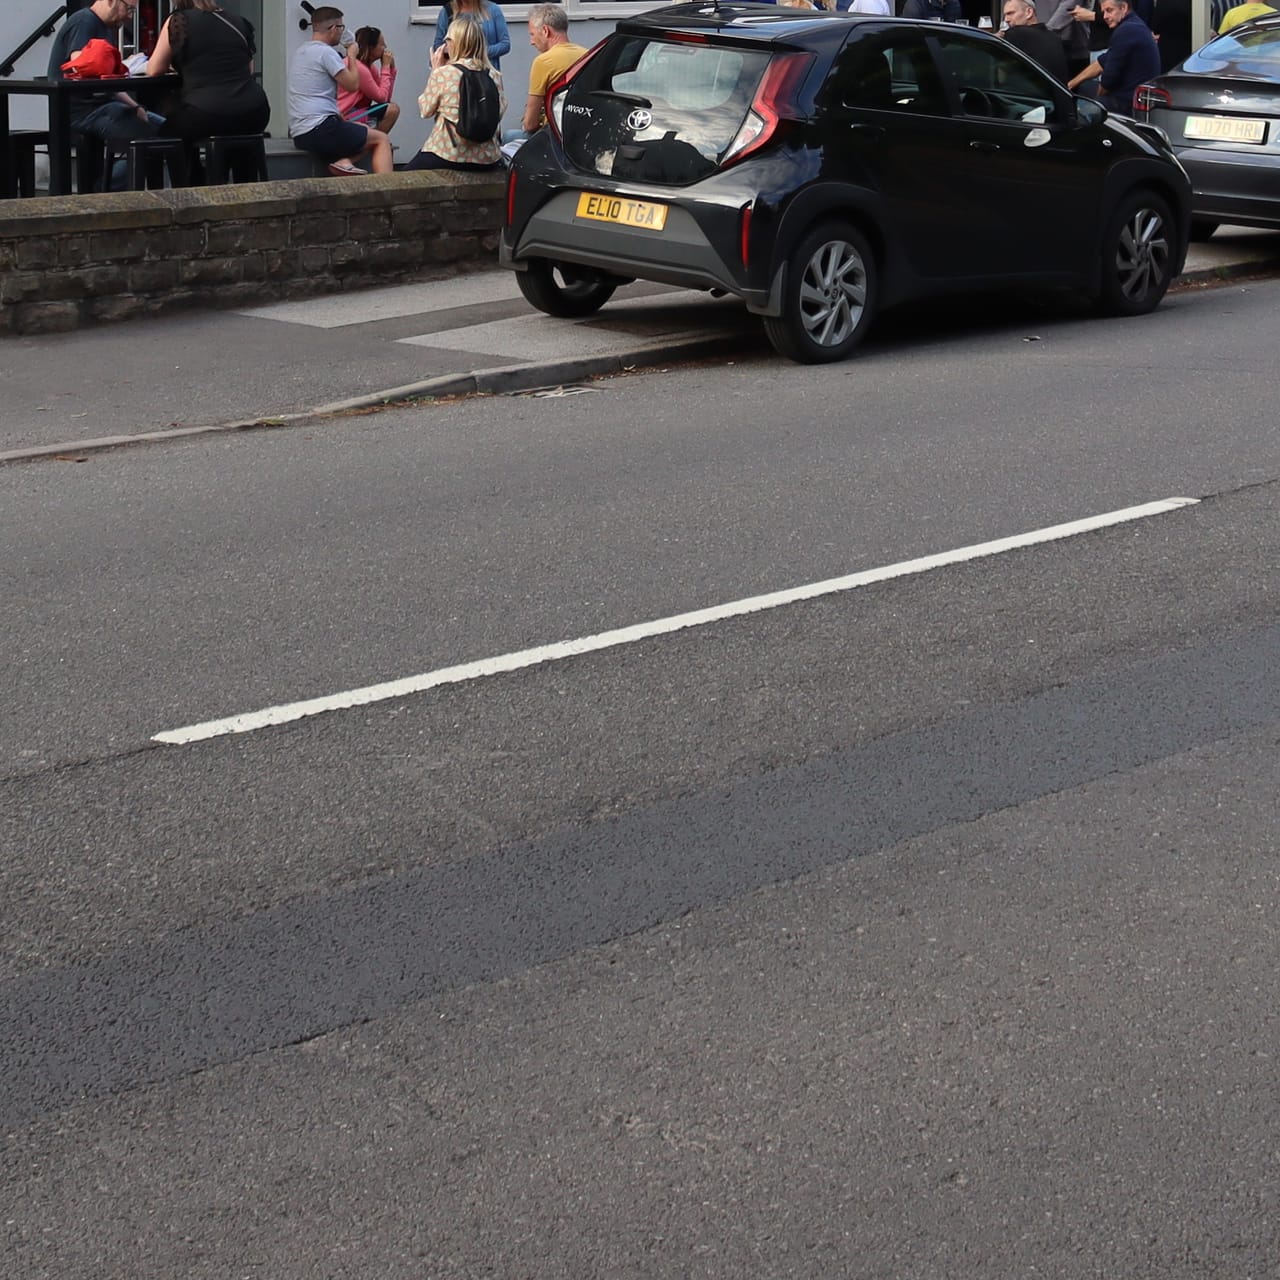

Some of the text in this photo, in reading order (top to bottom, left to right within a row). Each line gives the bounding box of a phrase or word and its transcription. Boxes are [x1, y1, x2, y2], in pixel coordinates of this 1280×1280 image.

[566, 104, 584, 114] AYGO
[586, 197, 655, 224] EL10 TGA
